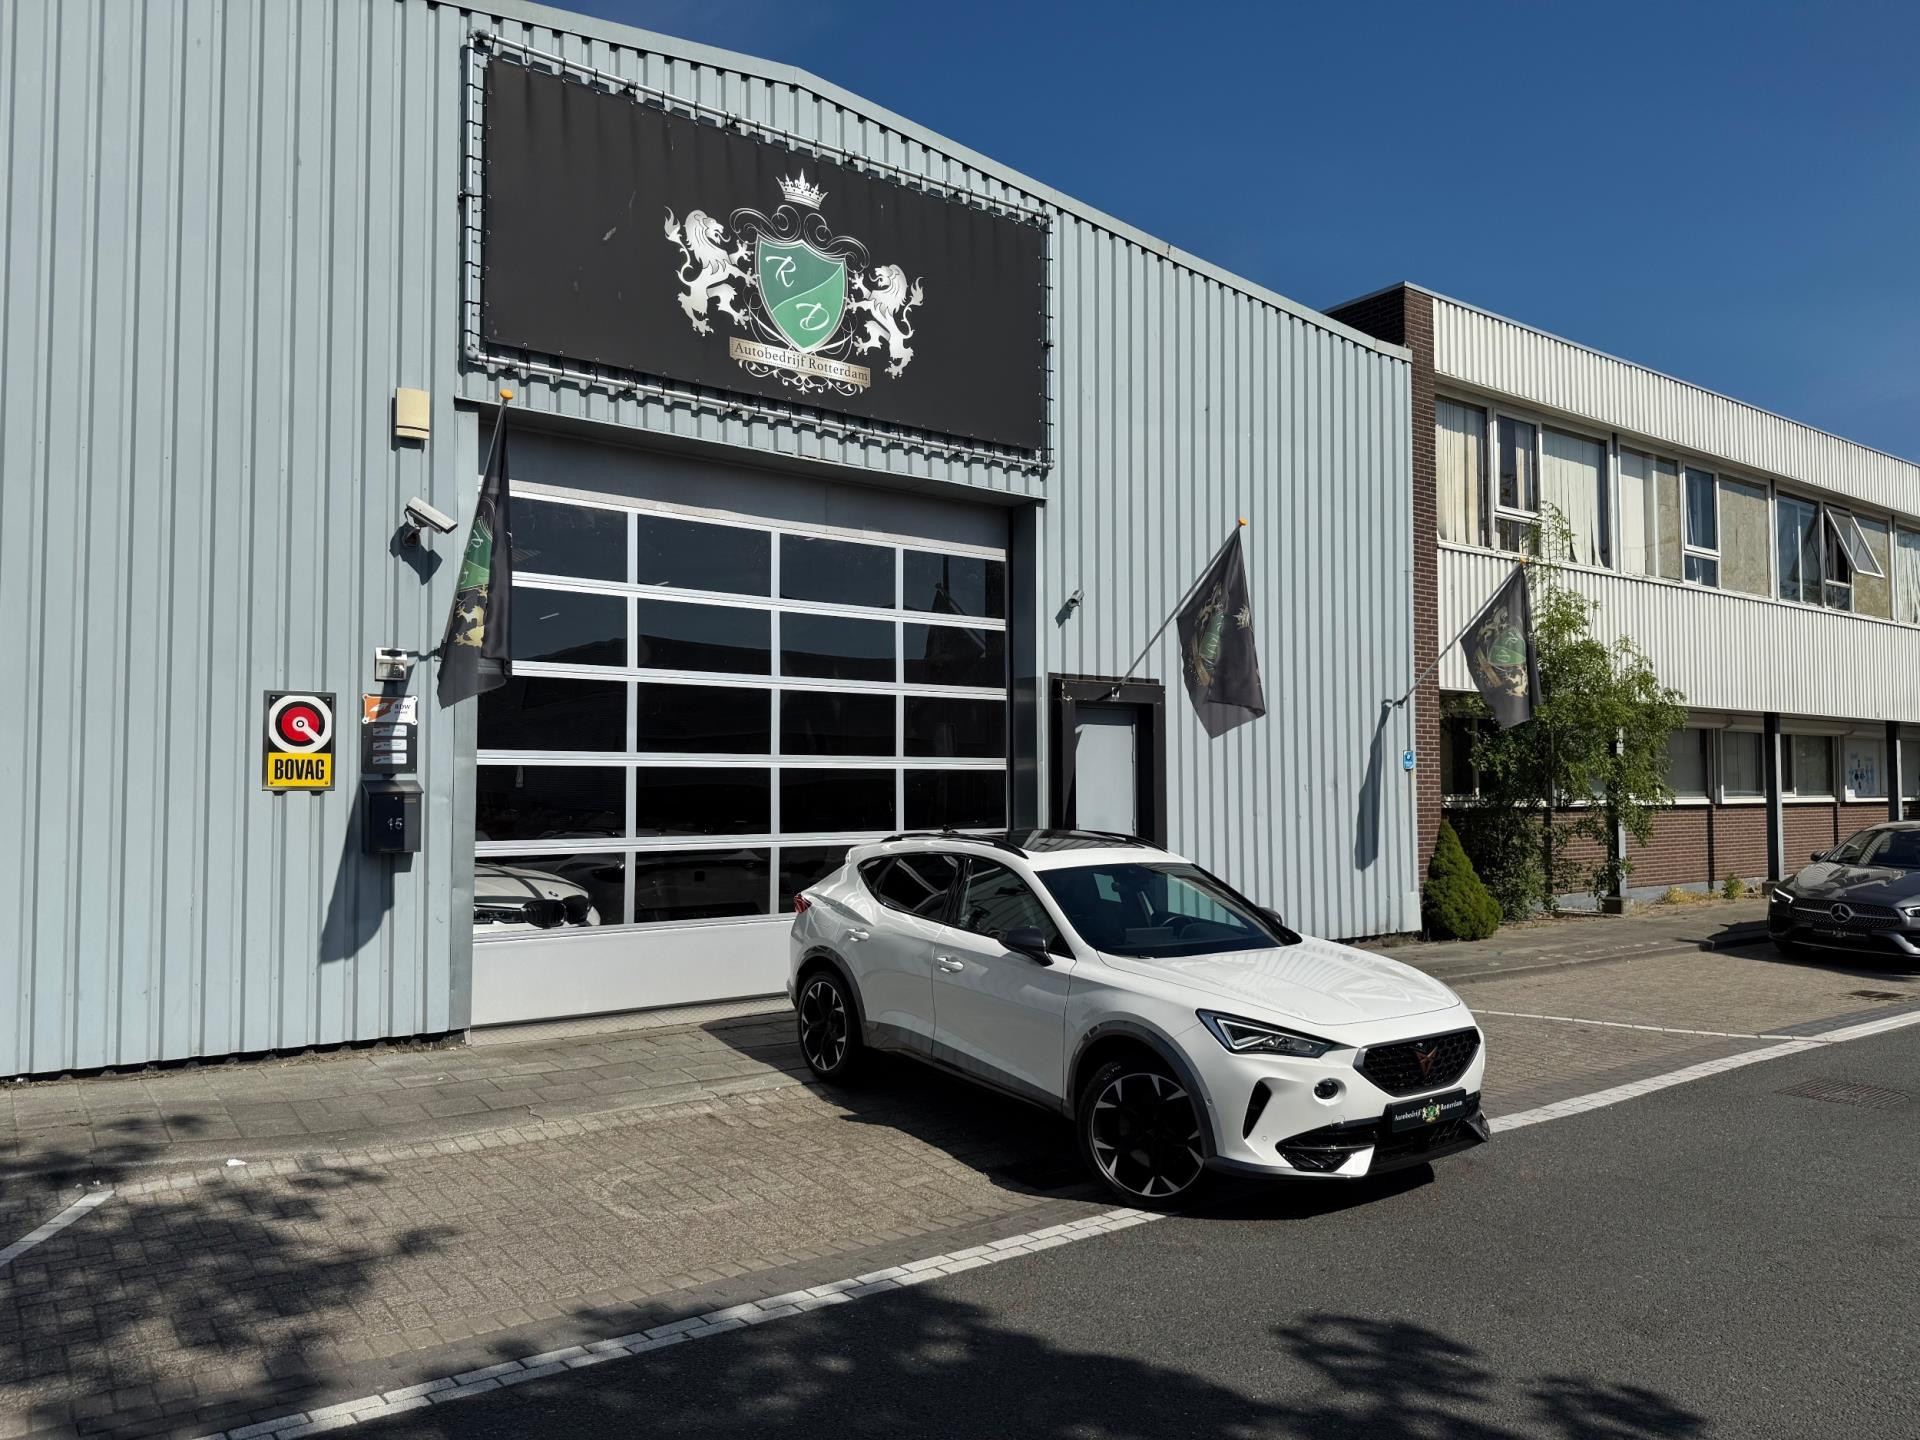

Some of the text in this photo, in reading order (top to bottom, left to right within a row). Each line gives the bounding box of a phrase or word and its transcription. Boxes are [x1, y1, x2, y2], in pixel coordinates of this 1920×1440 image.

[734, 342, 869, 381] Autobedrijf Rotterdam
[274, 758, 325, 780] BOVAG
